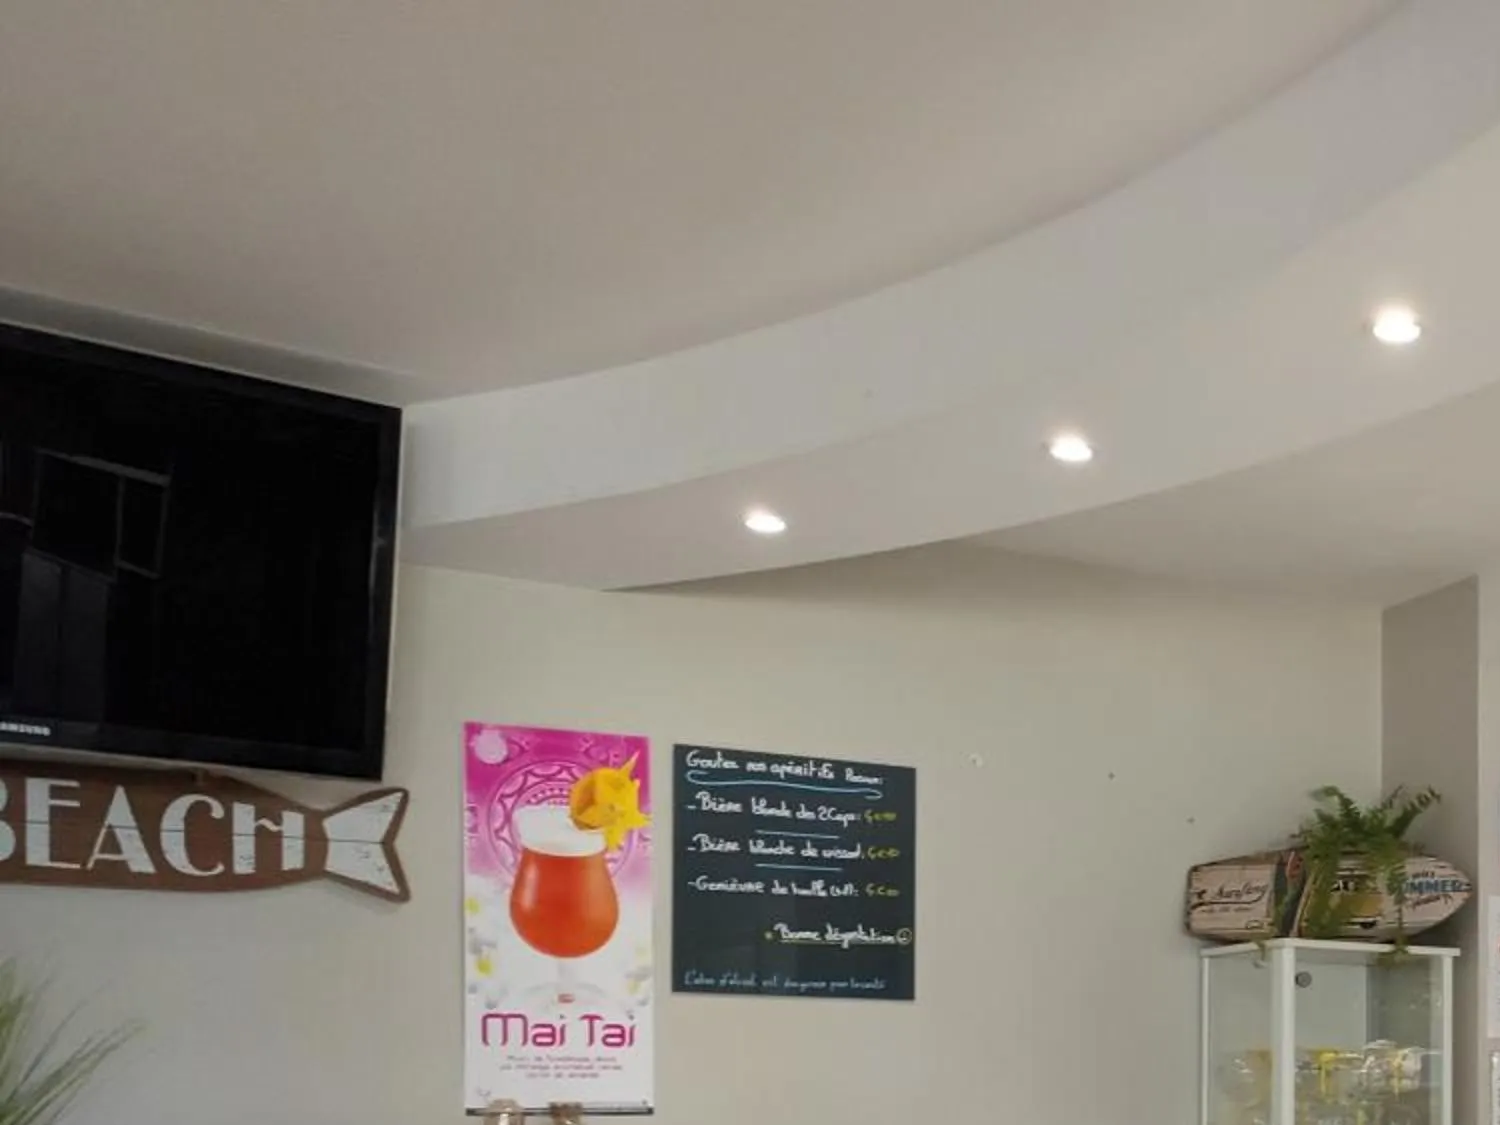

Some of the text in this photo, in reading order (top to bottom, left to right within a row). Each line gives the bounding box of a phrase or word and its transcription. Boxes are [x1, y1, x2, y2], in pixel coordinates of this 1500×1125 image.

[0, 721, 51, 736] AMSUNG
[482, 1013, 636, 1047] Mai Tai
